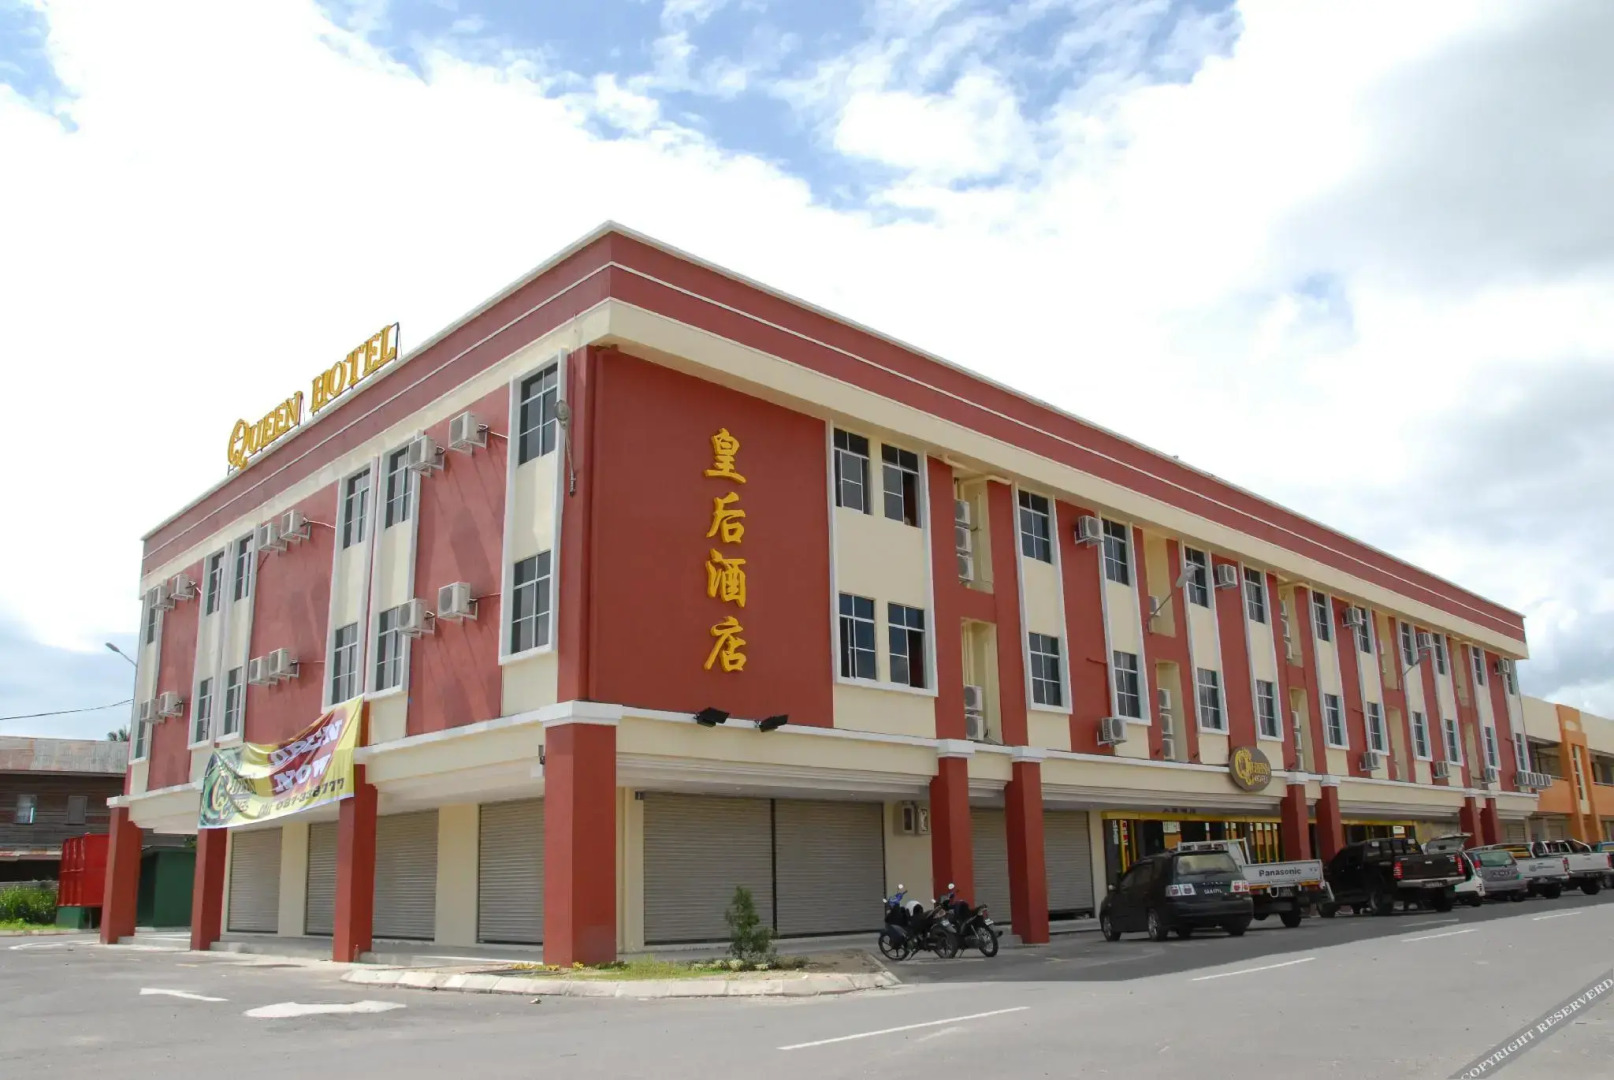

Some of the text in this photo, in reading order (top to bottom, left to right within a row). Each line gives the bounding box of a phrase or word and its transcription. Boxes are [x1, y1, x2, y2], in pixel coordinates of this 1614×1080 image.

[228, 325, 396, 469] QUEEN HOTEL
[704, 428, 747, 673] 皇后酒店
[270, 719, 342, 766] OPEN
[274, 754, 331, 793] NOW
[1259, 867, 1302, 877] Panasonic
